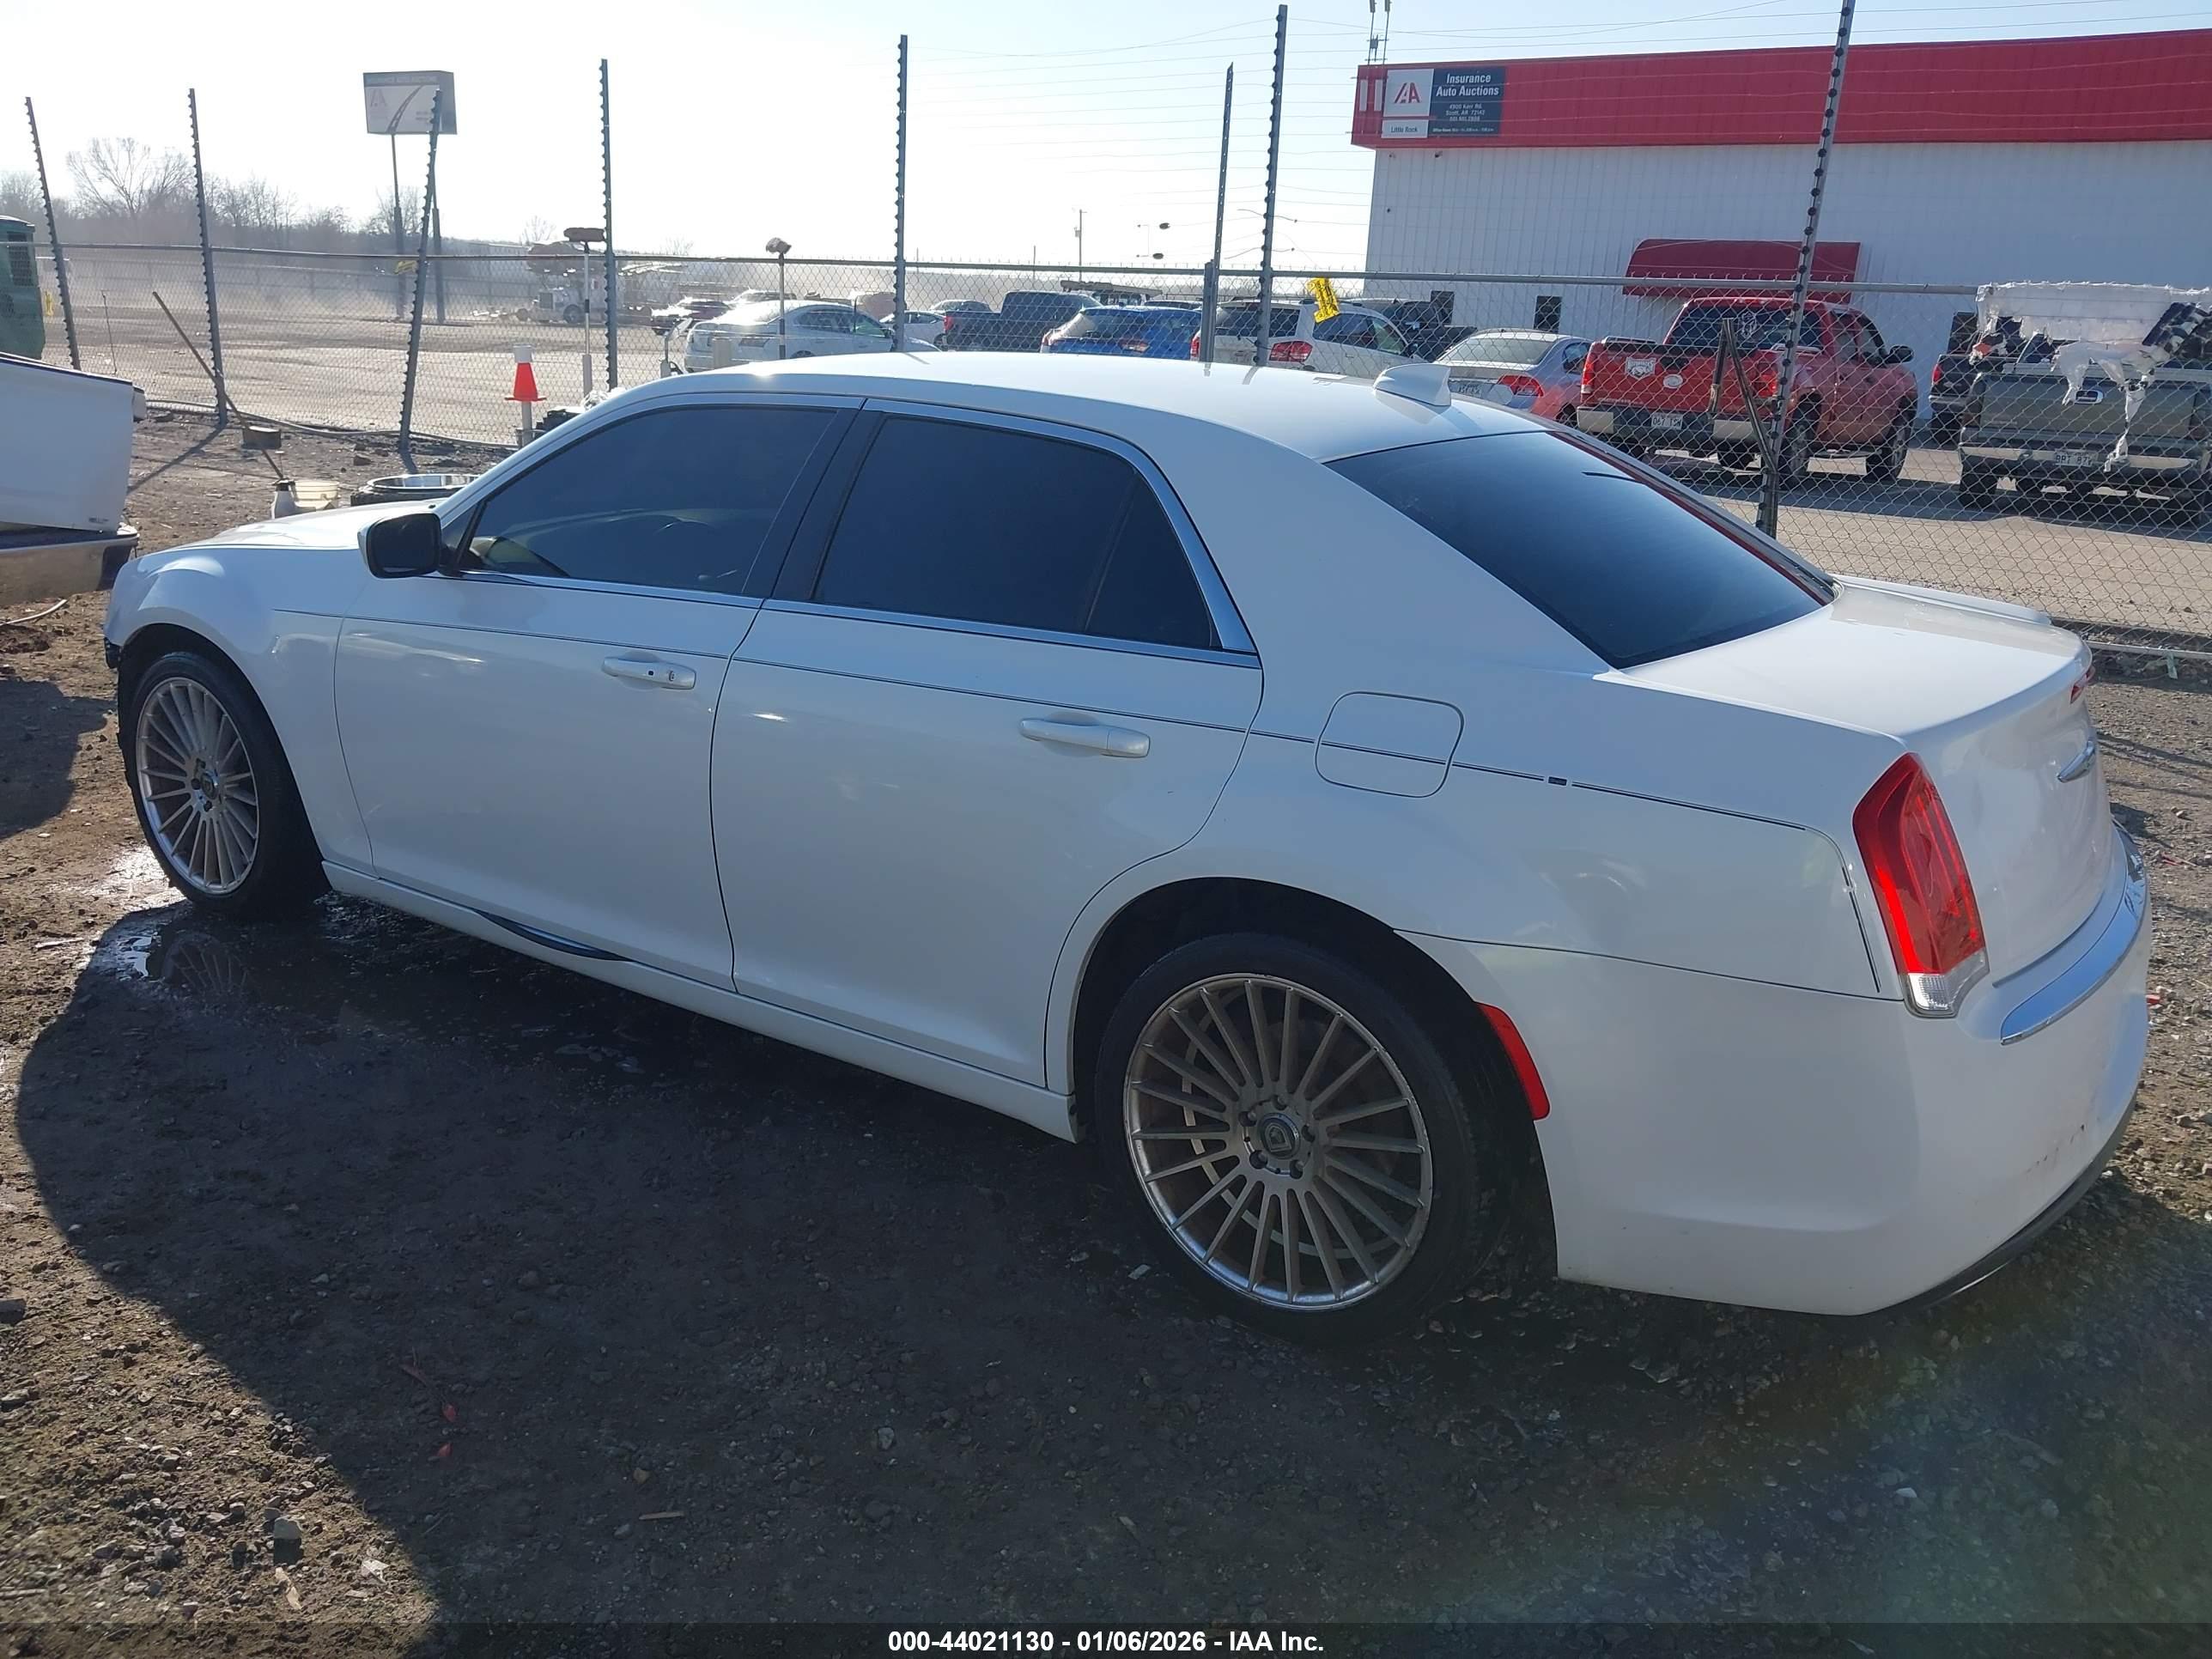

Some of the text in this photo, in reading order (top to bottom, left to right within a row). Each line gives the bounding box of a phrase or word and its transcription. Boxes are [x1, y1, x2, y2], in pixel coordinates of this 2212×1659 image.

[1446, 73, 1492, 84] Insurance
[1436, 85, 1499, 97] Auto Auctions
